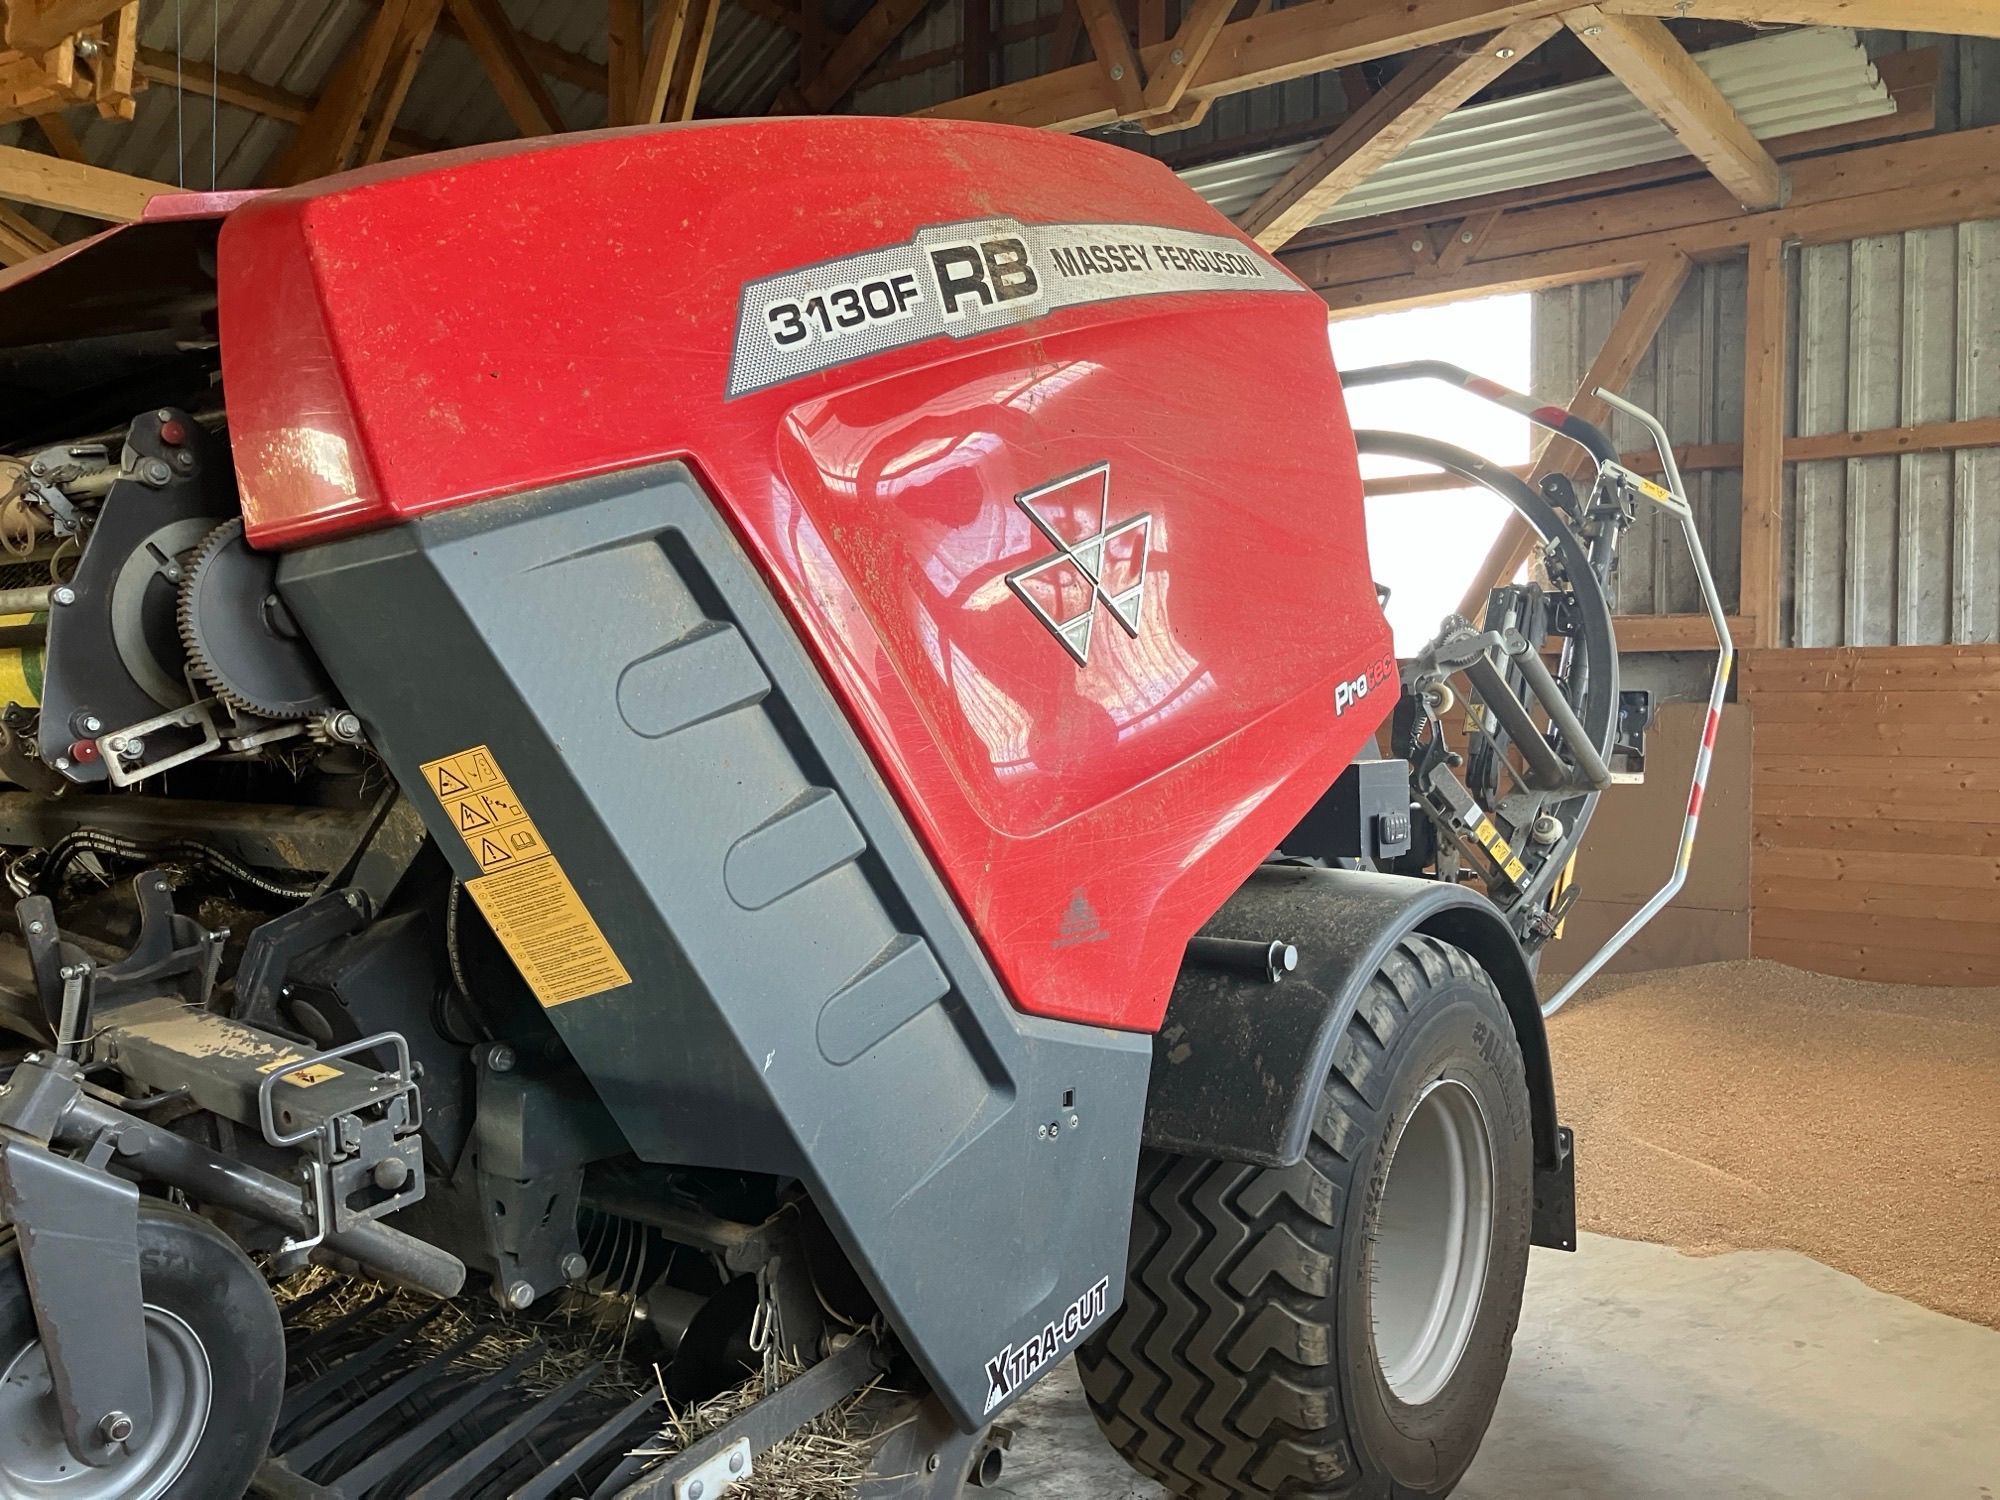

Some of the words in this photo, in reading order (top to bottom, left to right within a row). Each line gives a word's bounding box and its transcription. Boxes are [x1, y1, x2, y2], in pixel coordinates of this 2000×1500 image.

[767, 274, 920, 347] 3130F
[930, 237, 1040, 314] RB
[1051, 244, 1153, 278] MASSEY
[1156, 244, 1262, 278] FERGUSON
[983, 1274, 1109, 1416] XTRA-CUT
